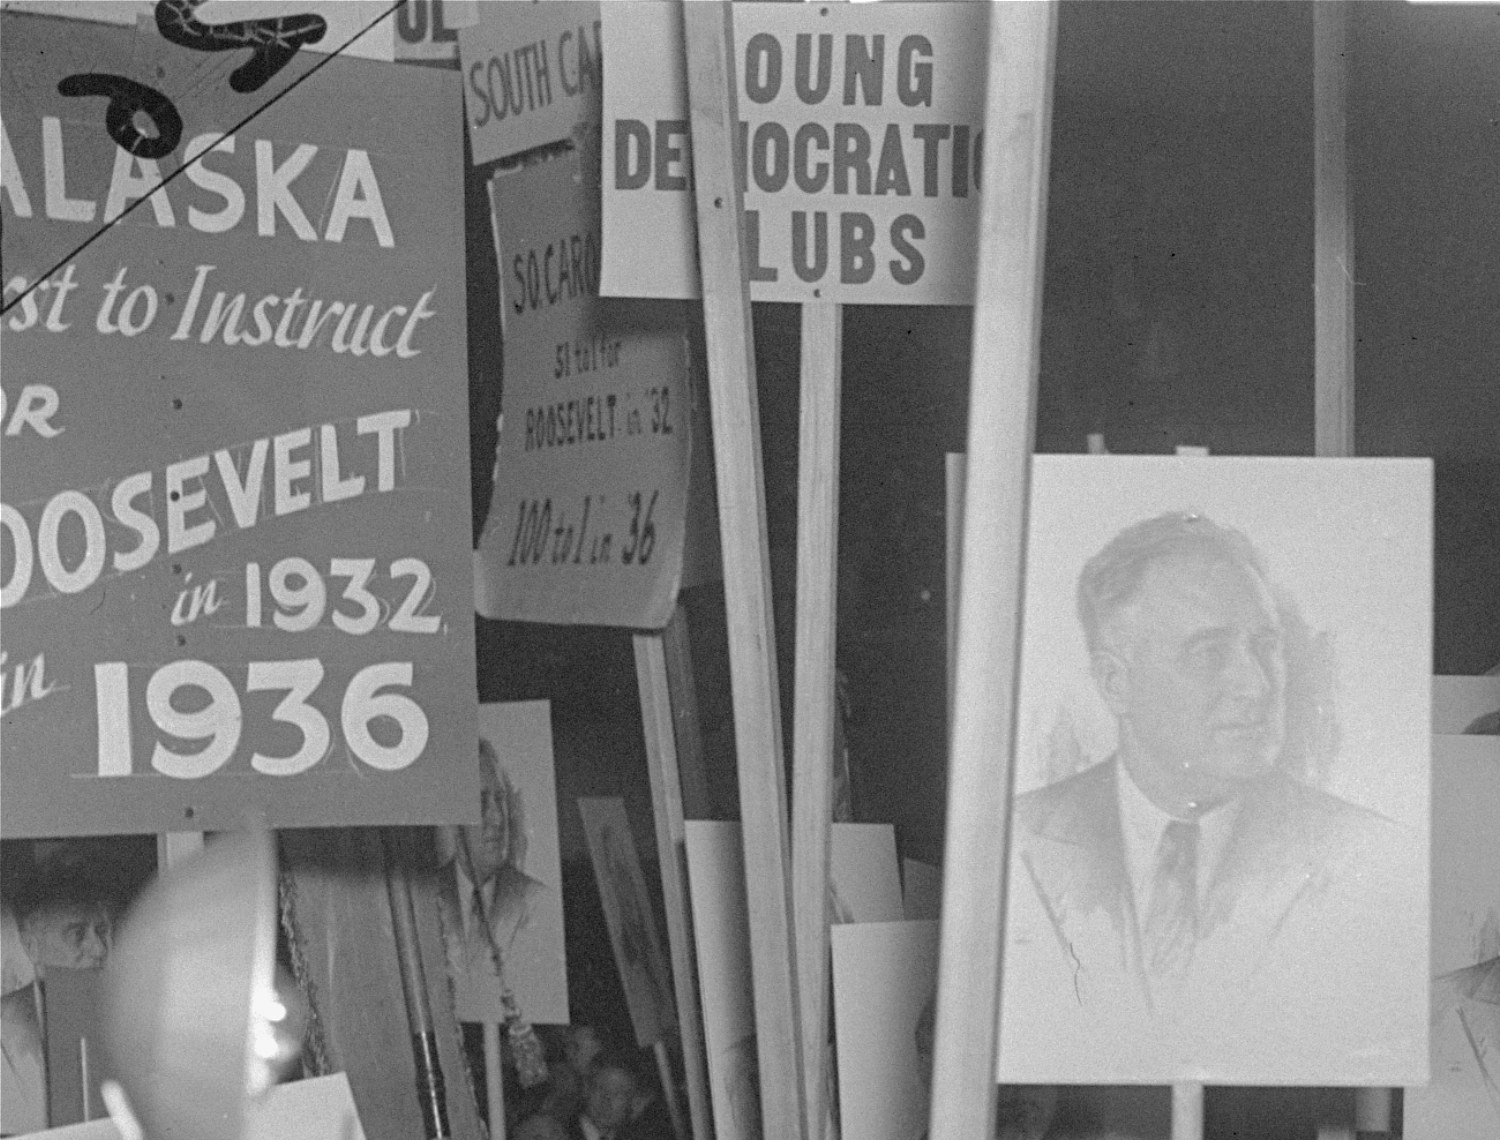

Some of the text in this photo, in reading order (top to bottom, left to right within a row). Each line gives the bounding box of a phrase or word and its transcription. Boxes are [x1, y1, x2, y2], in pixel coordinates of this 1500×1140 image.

[470, 39, 552, 127] SOUTH
[744, 32, 934, 107] OUNG
[614, 119, 984, 198] DEOCRATI
[744, 209, 926, 285] LUBS
[97, 264, 158, 337] to
[170, 264, 438, 359] Instruct
[0, 384, 66, 438] R
[524, 394, 618, 450] ROOSEVELT
[622, 489, 660, 567] 36
[171, 557, 441, 636] in 1932
[94, 658, 430, 779] 1936
